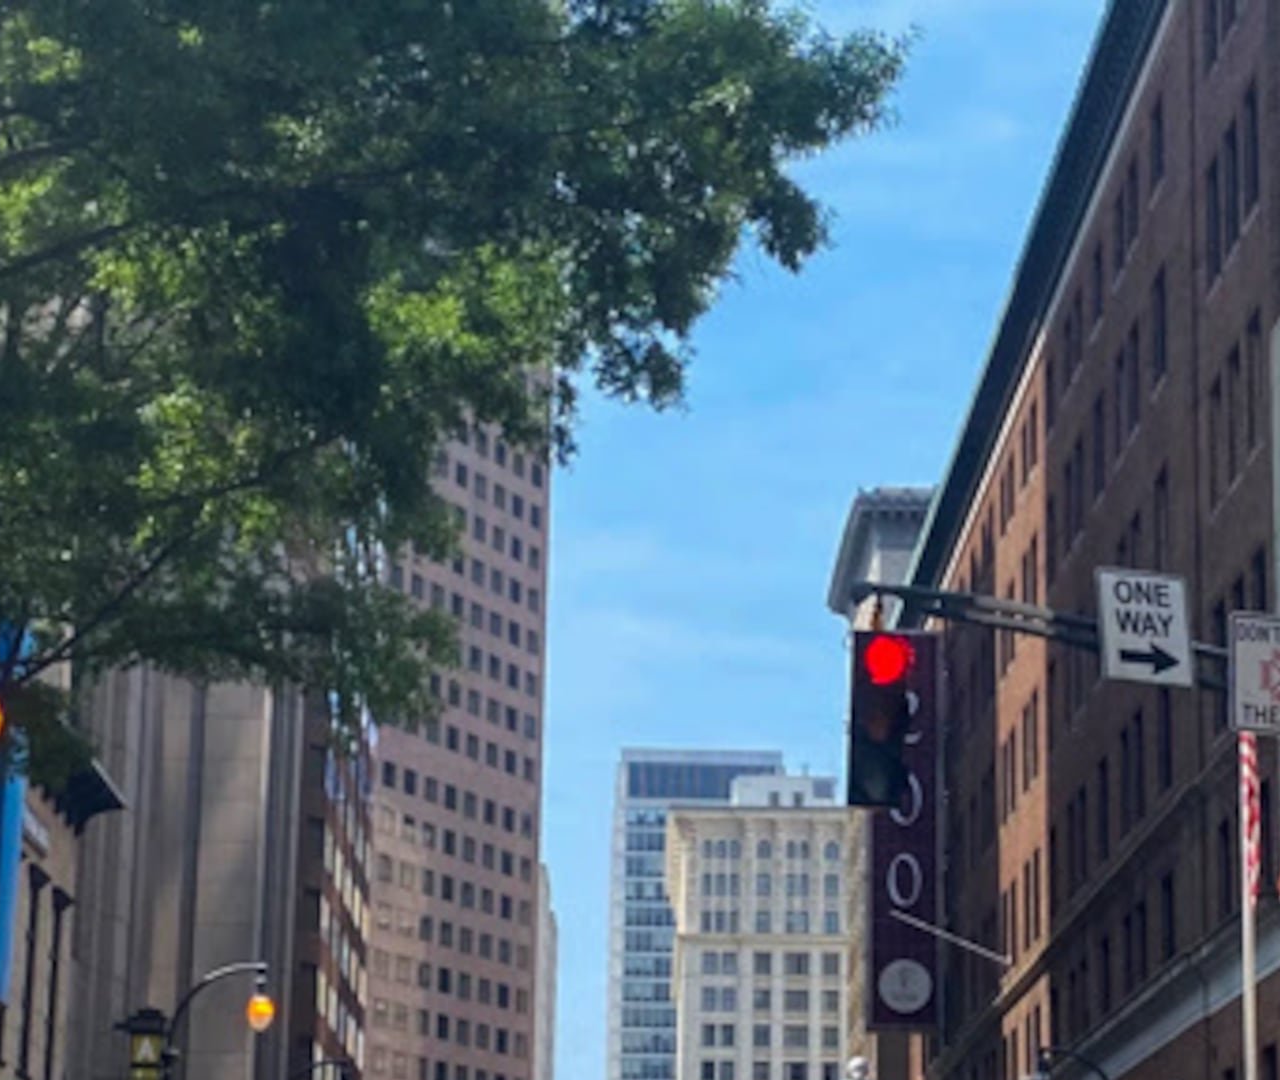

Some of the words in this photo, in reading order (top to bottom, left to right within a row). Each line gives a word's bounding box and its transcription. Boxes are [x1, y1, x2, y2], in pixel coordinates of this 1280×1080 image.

[1114, 580, 1172, 608] ONE
[1116, 608, 1174, 639] WAY
[1243, 703, 1280, 727] THE
